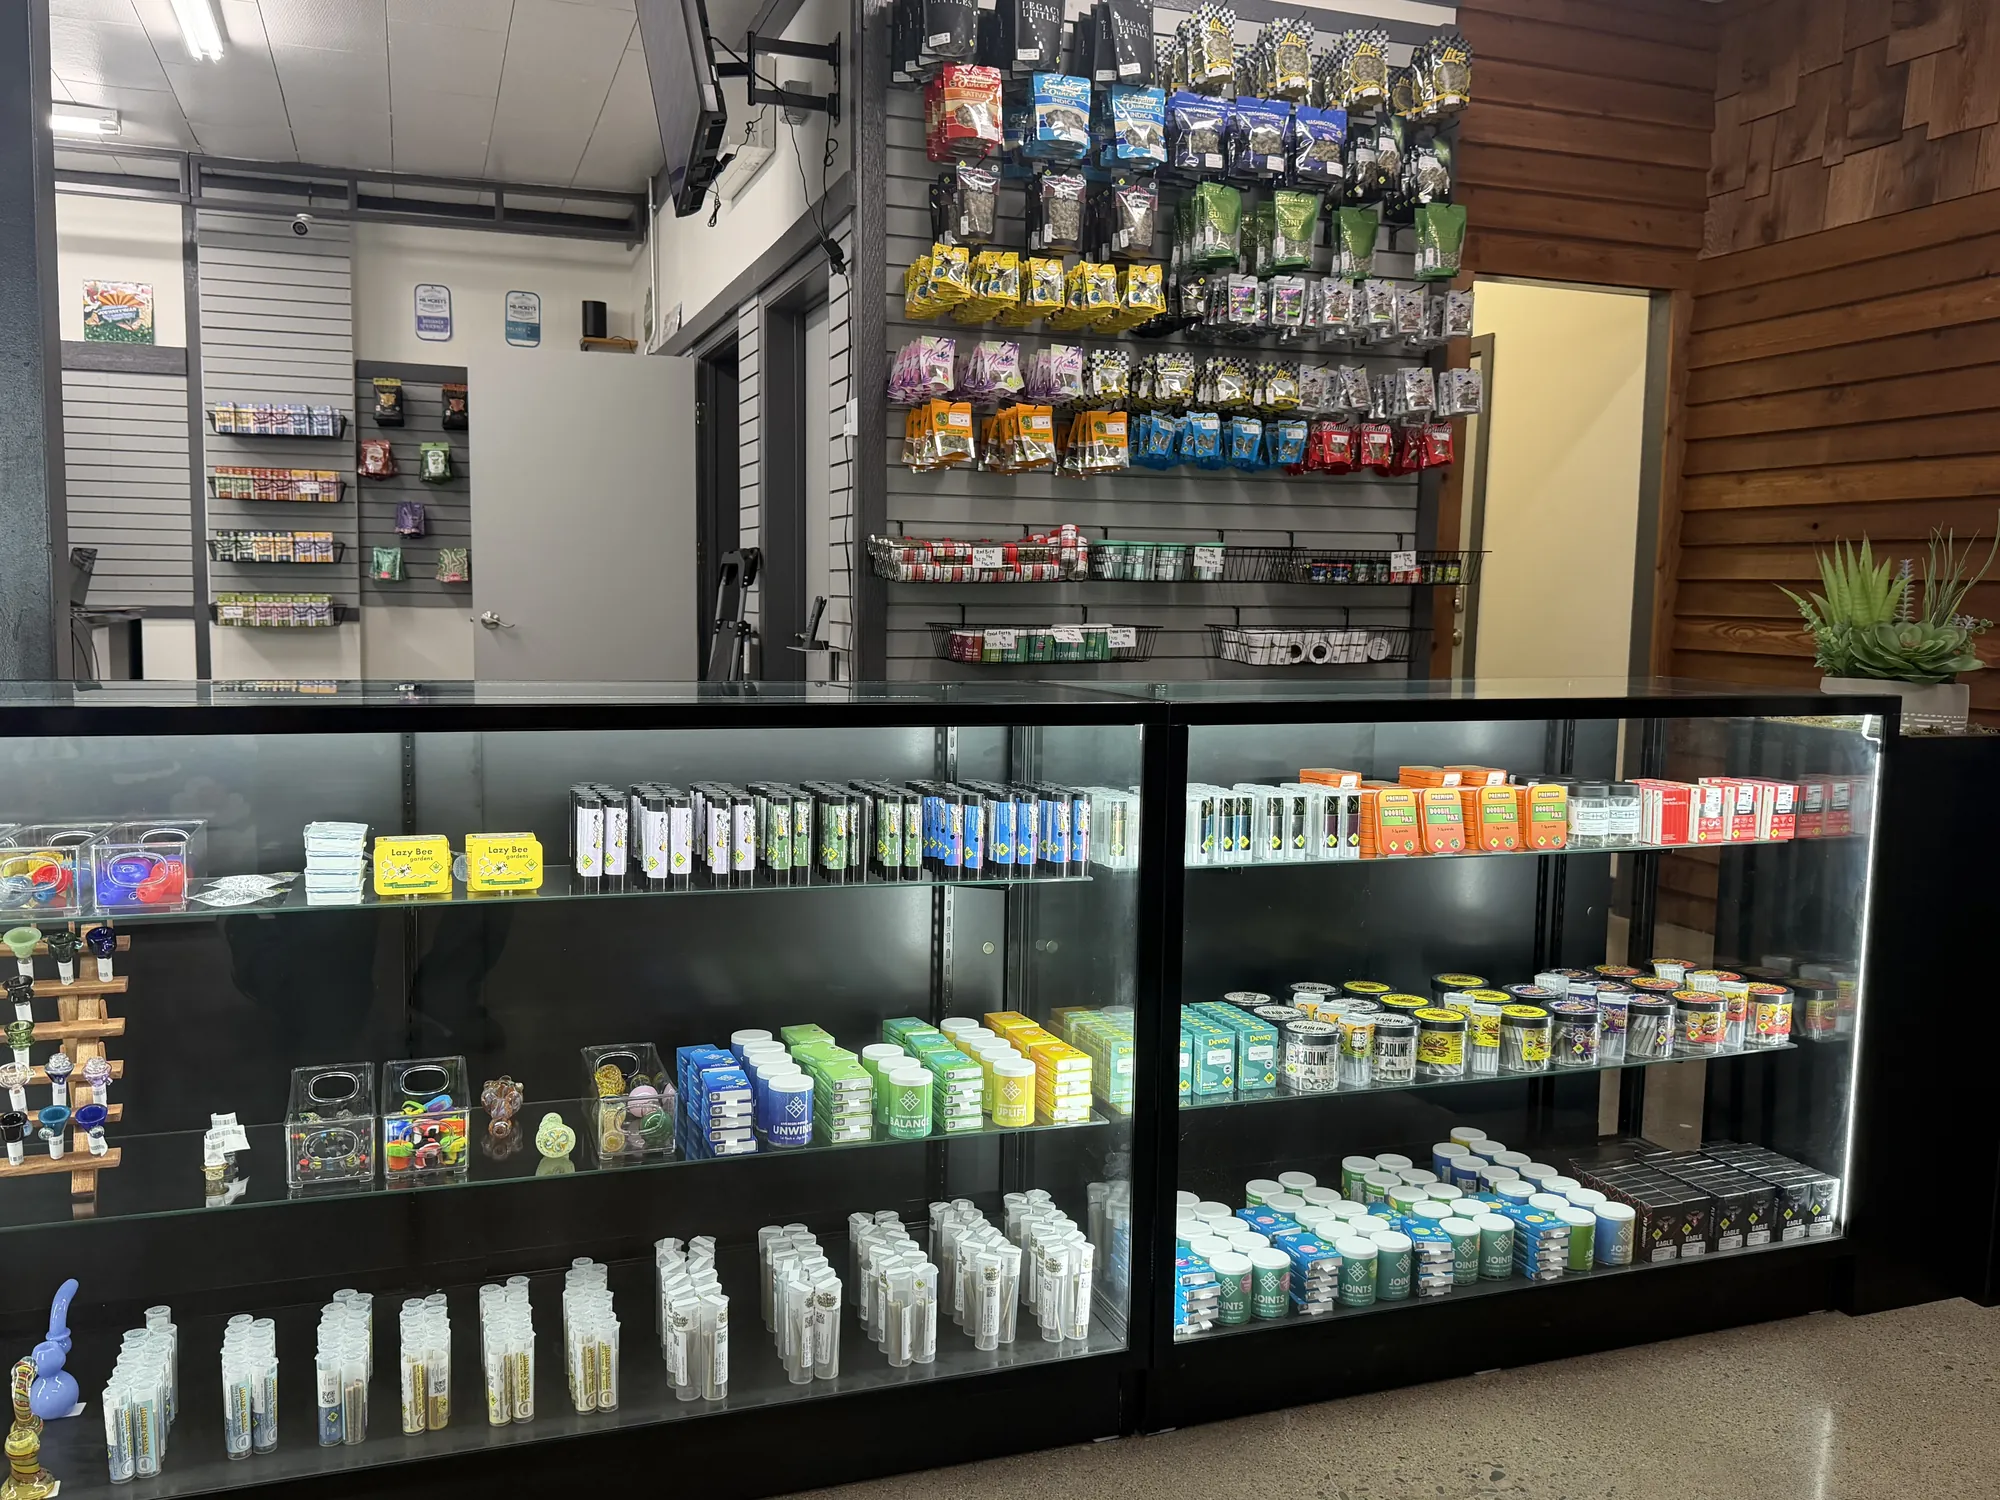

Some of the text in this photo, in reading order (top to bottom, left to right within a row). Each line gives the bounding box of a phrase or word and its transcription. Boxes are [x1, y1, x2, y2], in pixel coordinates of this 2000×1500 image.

[961, 90, 988, 99] SATIVA
[1384, 807, 1404, 817] DOOBIE
[1429, 807, 1450, 816] DOOBIE
[1486, 806, 1505, 815] DOOBIE
[1535, 805, 1555, 814] DOOBIE
[1401, 815, 1414, 823] PAX
[1447, 813, 1459, 822] PAX
[1502, 812, 1514, 820] PAX
[1551, 810, 1563, 819] PAX
[392, 849, 413, 858] Lazy
[488, 846, 509, 855] Lazy
[997, 1106, 1025, 1117] UPLIFT
[890, 1116, 929, 1129] BALANCE
[773, 1122, 813, 1135] UNWIND
[1686, 1234, 1702, 1242] EAGLE
[1611, 1244, 1630, 1253] JOIN
[1455, 1259, 1478, 1269] OINTS
[1341, 1284, 1372, 1293] JOINTS
[1254, 1294, 1284, 1304] JOINTS
[1218, 1301, 1244, 1310] OINTS
